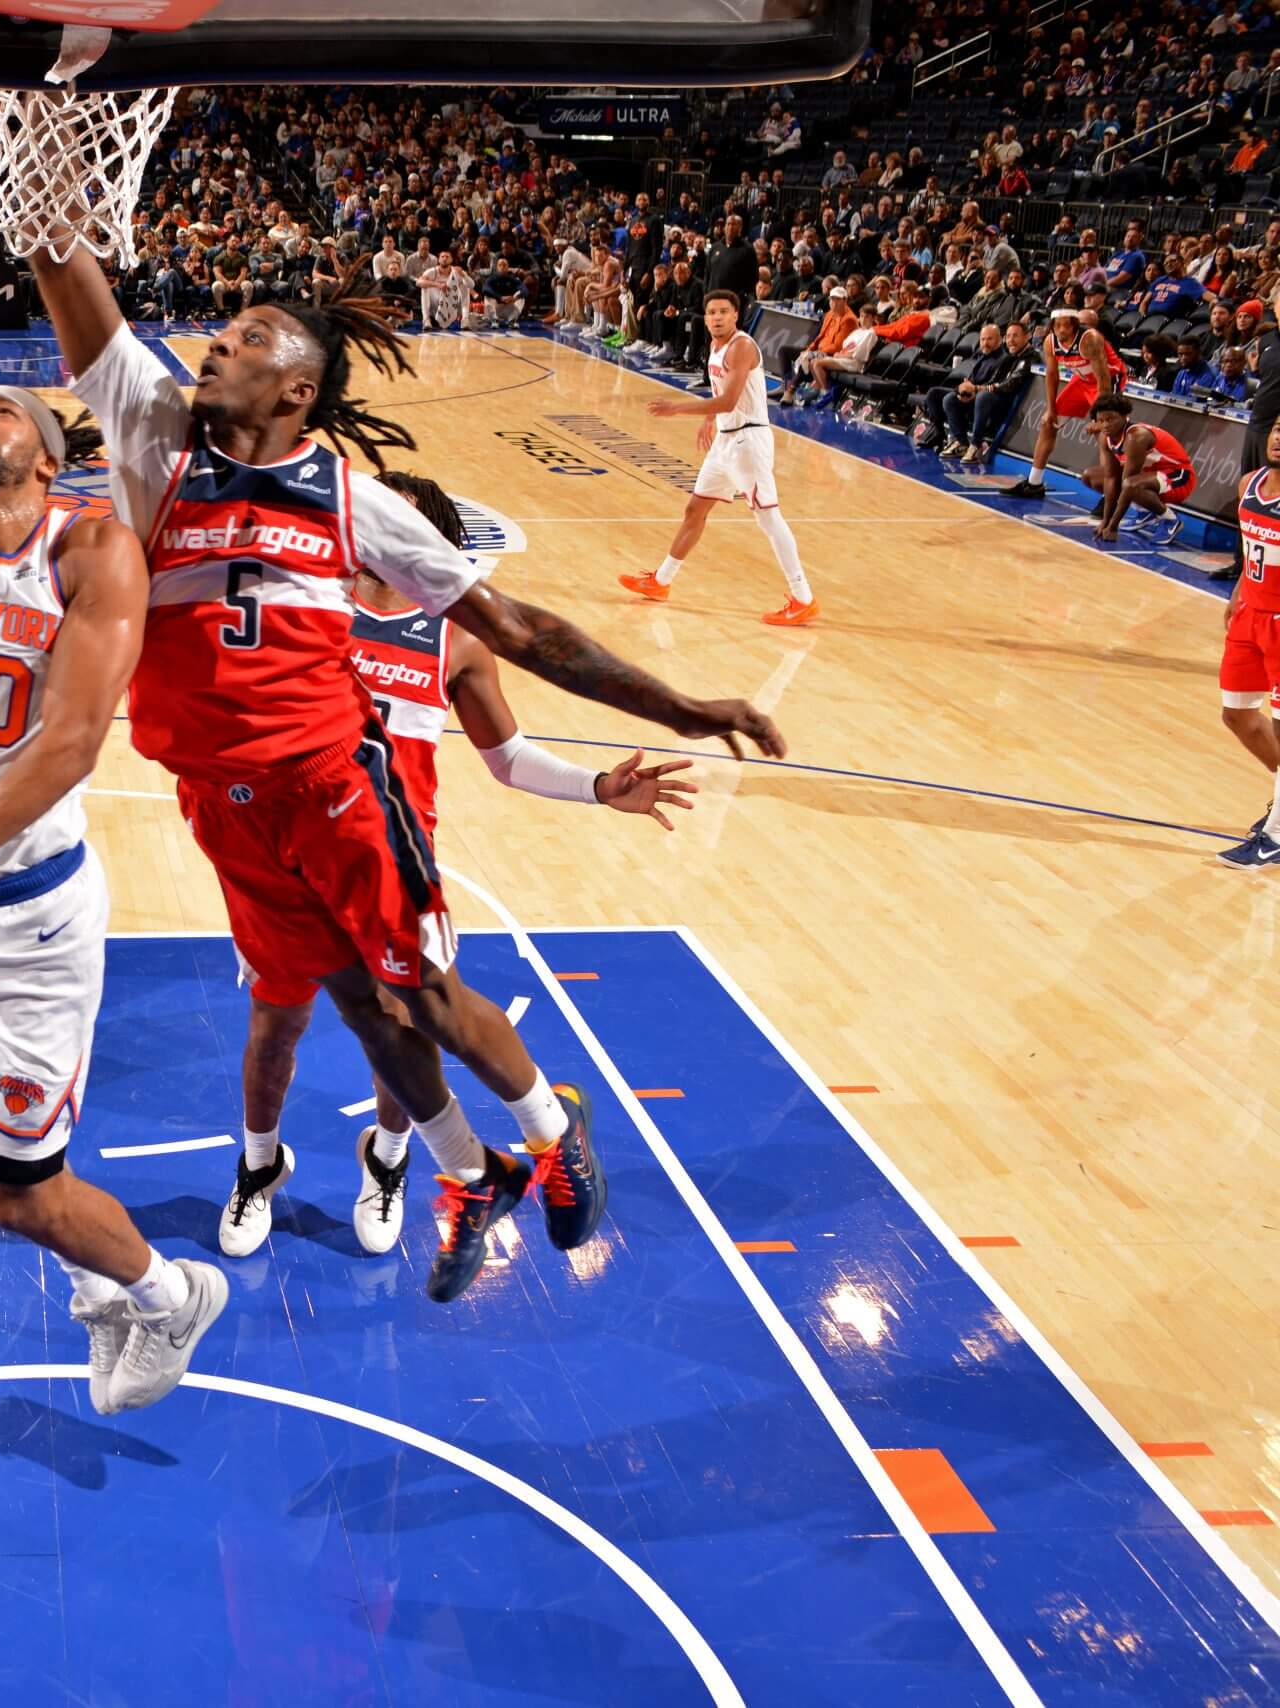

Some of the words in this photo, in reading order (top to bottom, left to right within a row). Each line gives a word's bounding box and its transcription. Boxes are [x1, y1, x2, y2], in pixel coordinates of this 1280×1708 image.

[550, 108, 602, 123] Michelob
[617, 108, 670, 123] ULTRA
[494, 431, 586, 464] CHASE
[163, 515, 334, 559] washington
[1245, 540, 1264, 583] 13
[220, 561, 263, 650] 5
[350, 649, 432, 689] hington
